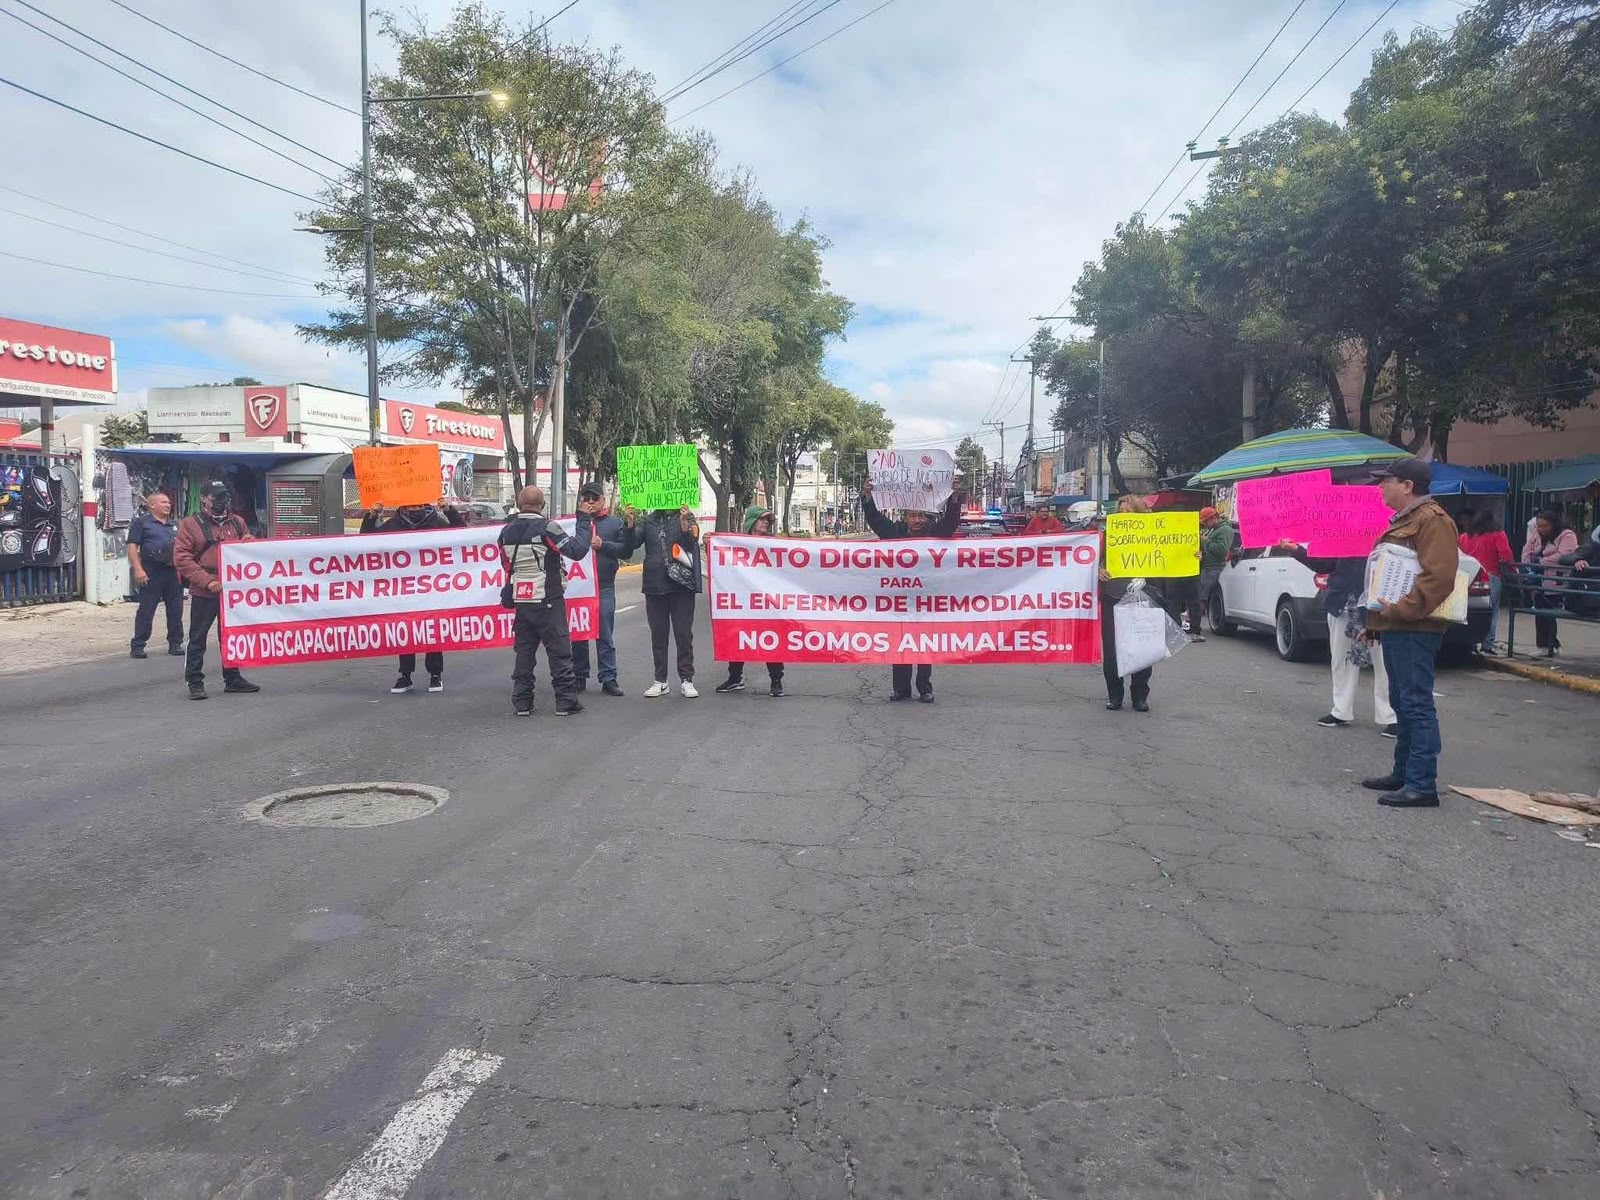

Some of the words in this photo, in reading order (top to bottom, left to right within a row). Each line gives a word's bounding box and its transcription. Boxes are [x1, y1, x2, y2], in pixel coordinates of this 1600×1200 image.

[425, 413, 497, 440] Firestone
[1111, 519, 1145, 531] HARTOS
[1155, 518, 1166, 529] DE
[226, 561, 262, 582] NO
[271, 558, 303, 578] AL
[309, 550, 411, 575] CAMBIO
[419, 546, 454, 567] DE
[713, 546, 811, 568] TRATO
[820, 547, 919, 568] DIGNO
[928, 547, 948, 568] Y
[957, 545, 1097, 568] RESPETO
[1121, 550, 1166, 571] VIVIR
[229, 583, 320, 608] PONEN
[329, 580, 362, 601] EN
[373, 572, 472, 597] RIESGO
[880, 577, 923, 588] PARA
[716, 593, 743, 610] EL
[750, 593, 867, 612] ENFERMO
[876, 595, 908, 612] DE
[916, 591, 1093, 612] HEMODIALISIS
[227, 634, 256, 661] SOY
[260, 621, 382, 657] DISCAPACITADO
[386, 621, 410, 647] NO
[413, 618, 437, 645] ME
[440, 614, 495, 643] PUEDO
[738, 631, 779, 650] NO
[787, 631, 889, 652] SOMOS
[897, 630, 1073, 652] ANIMALES...
